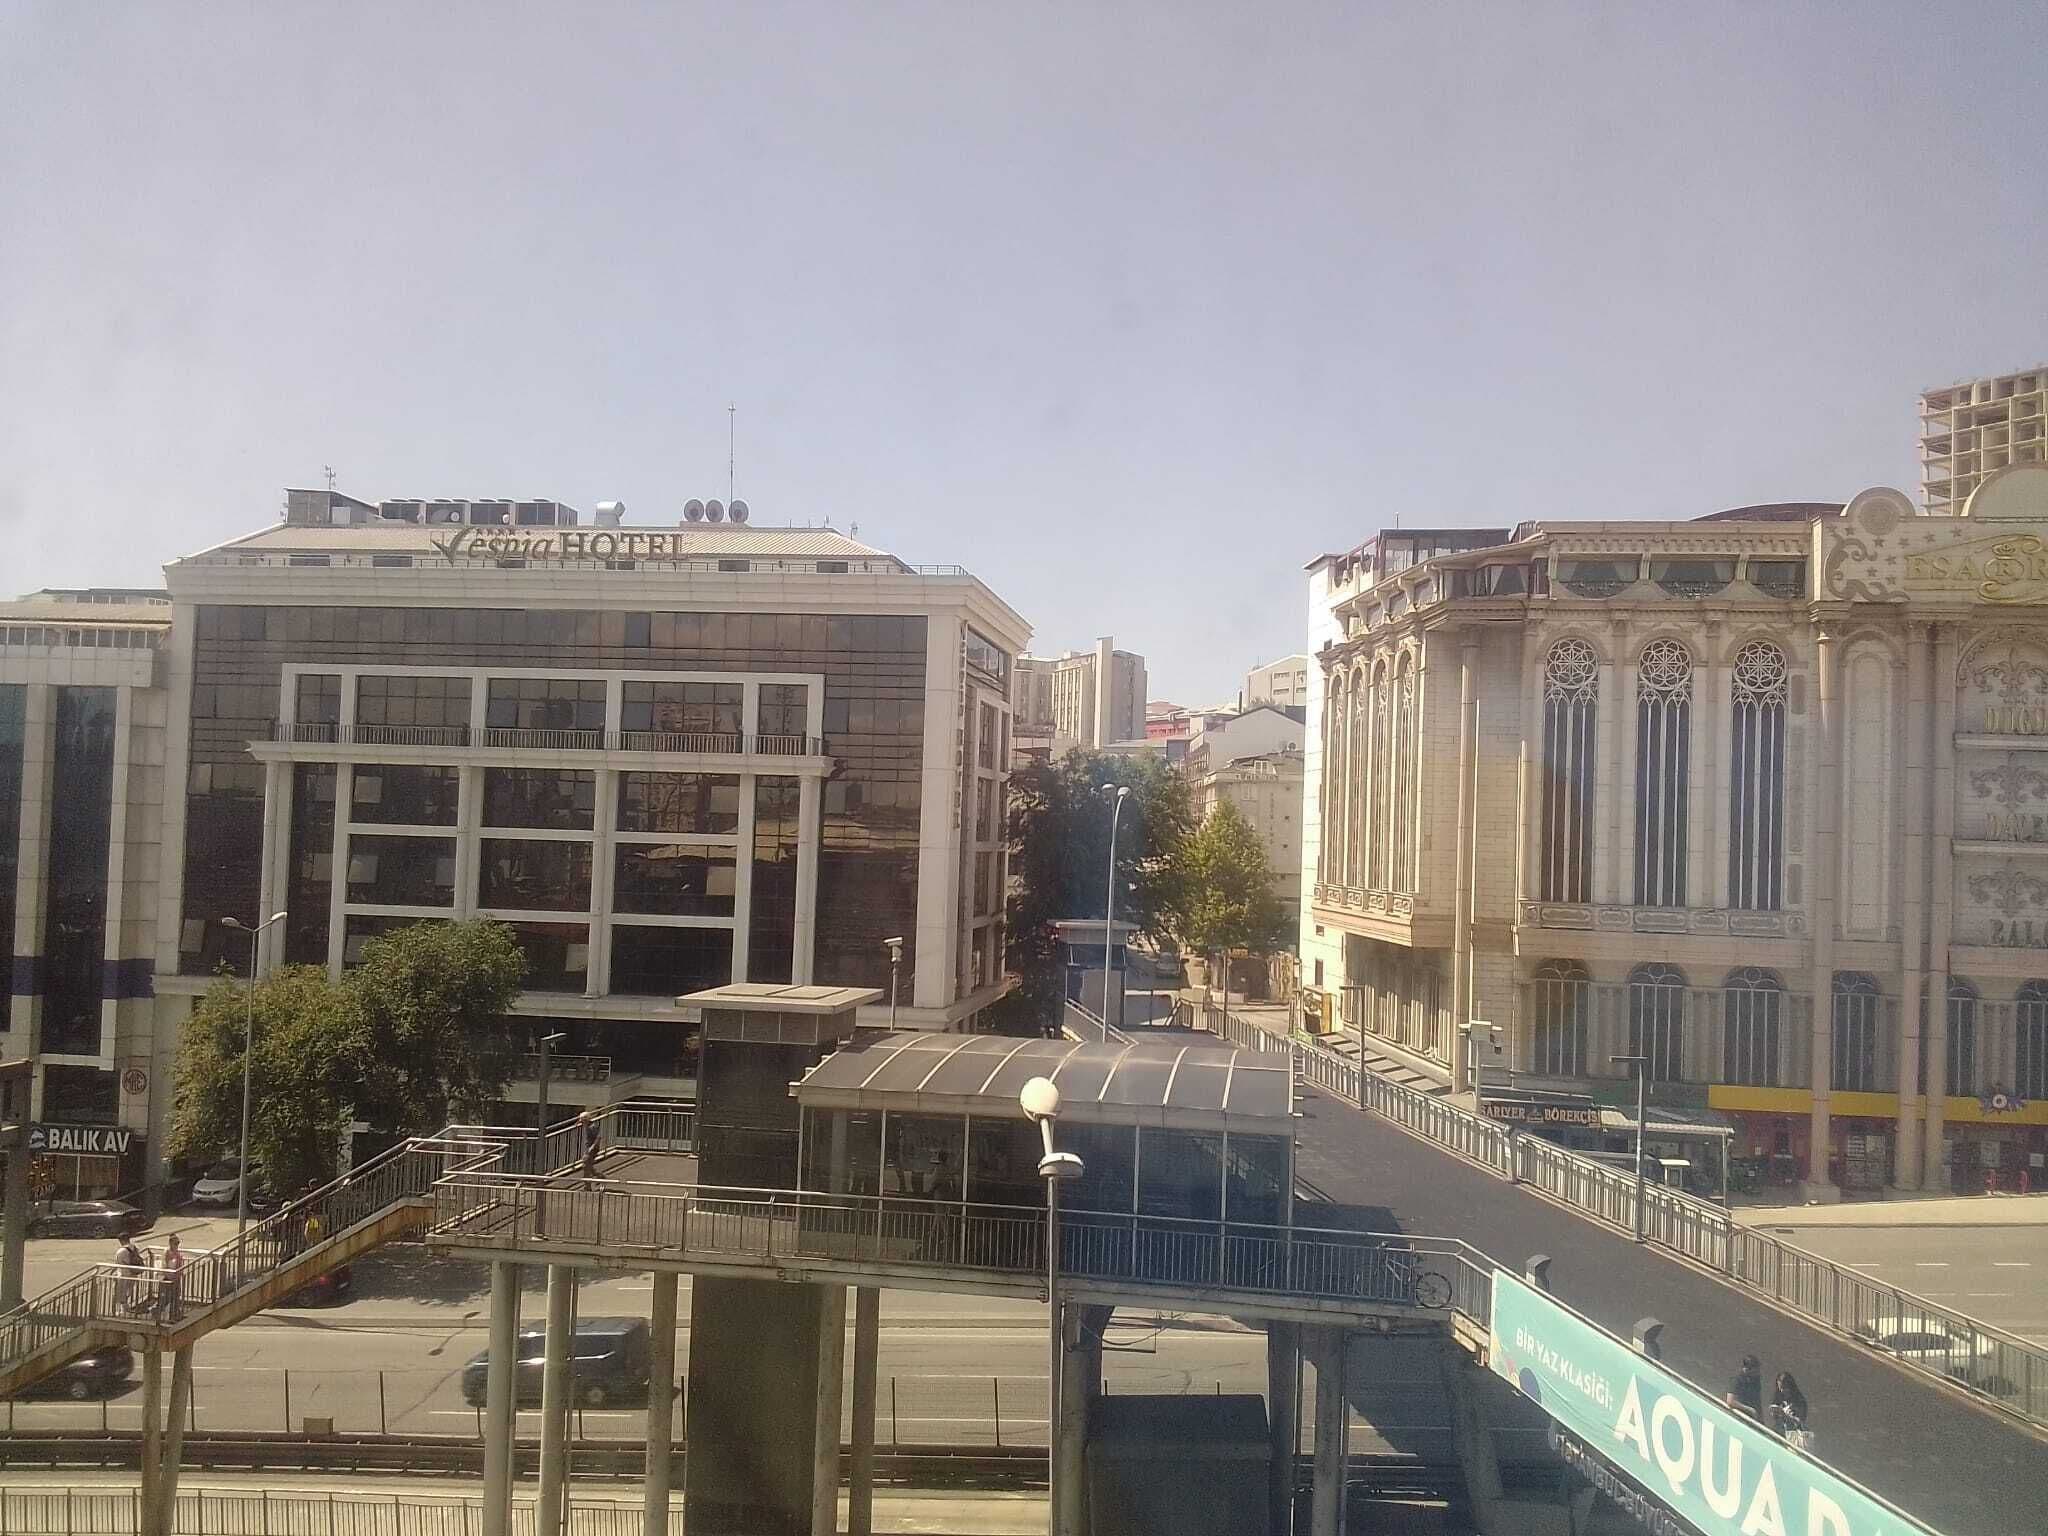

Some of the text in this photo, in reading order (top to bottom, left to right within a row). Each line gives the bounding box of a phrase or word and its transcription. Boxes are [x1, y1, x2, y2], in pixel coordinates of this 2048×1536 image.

[558, 532, 689, 561] HOTEL
[50, 1128, 130, 1153] BALIK AV
[1515, 1325, 1535, 1357] BİR
[1536, 1340, 1559, 1373] YAZ
